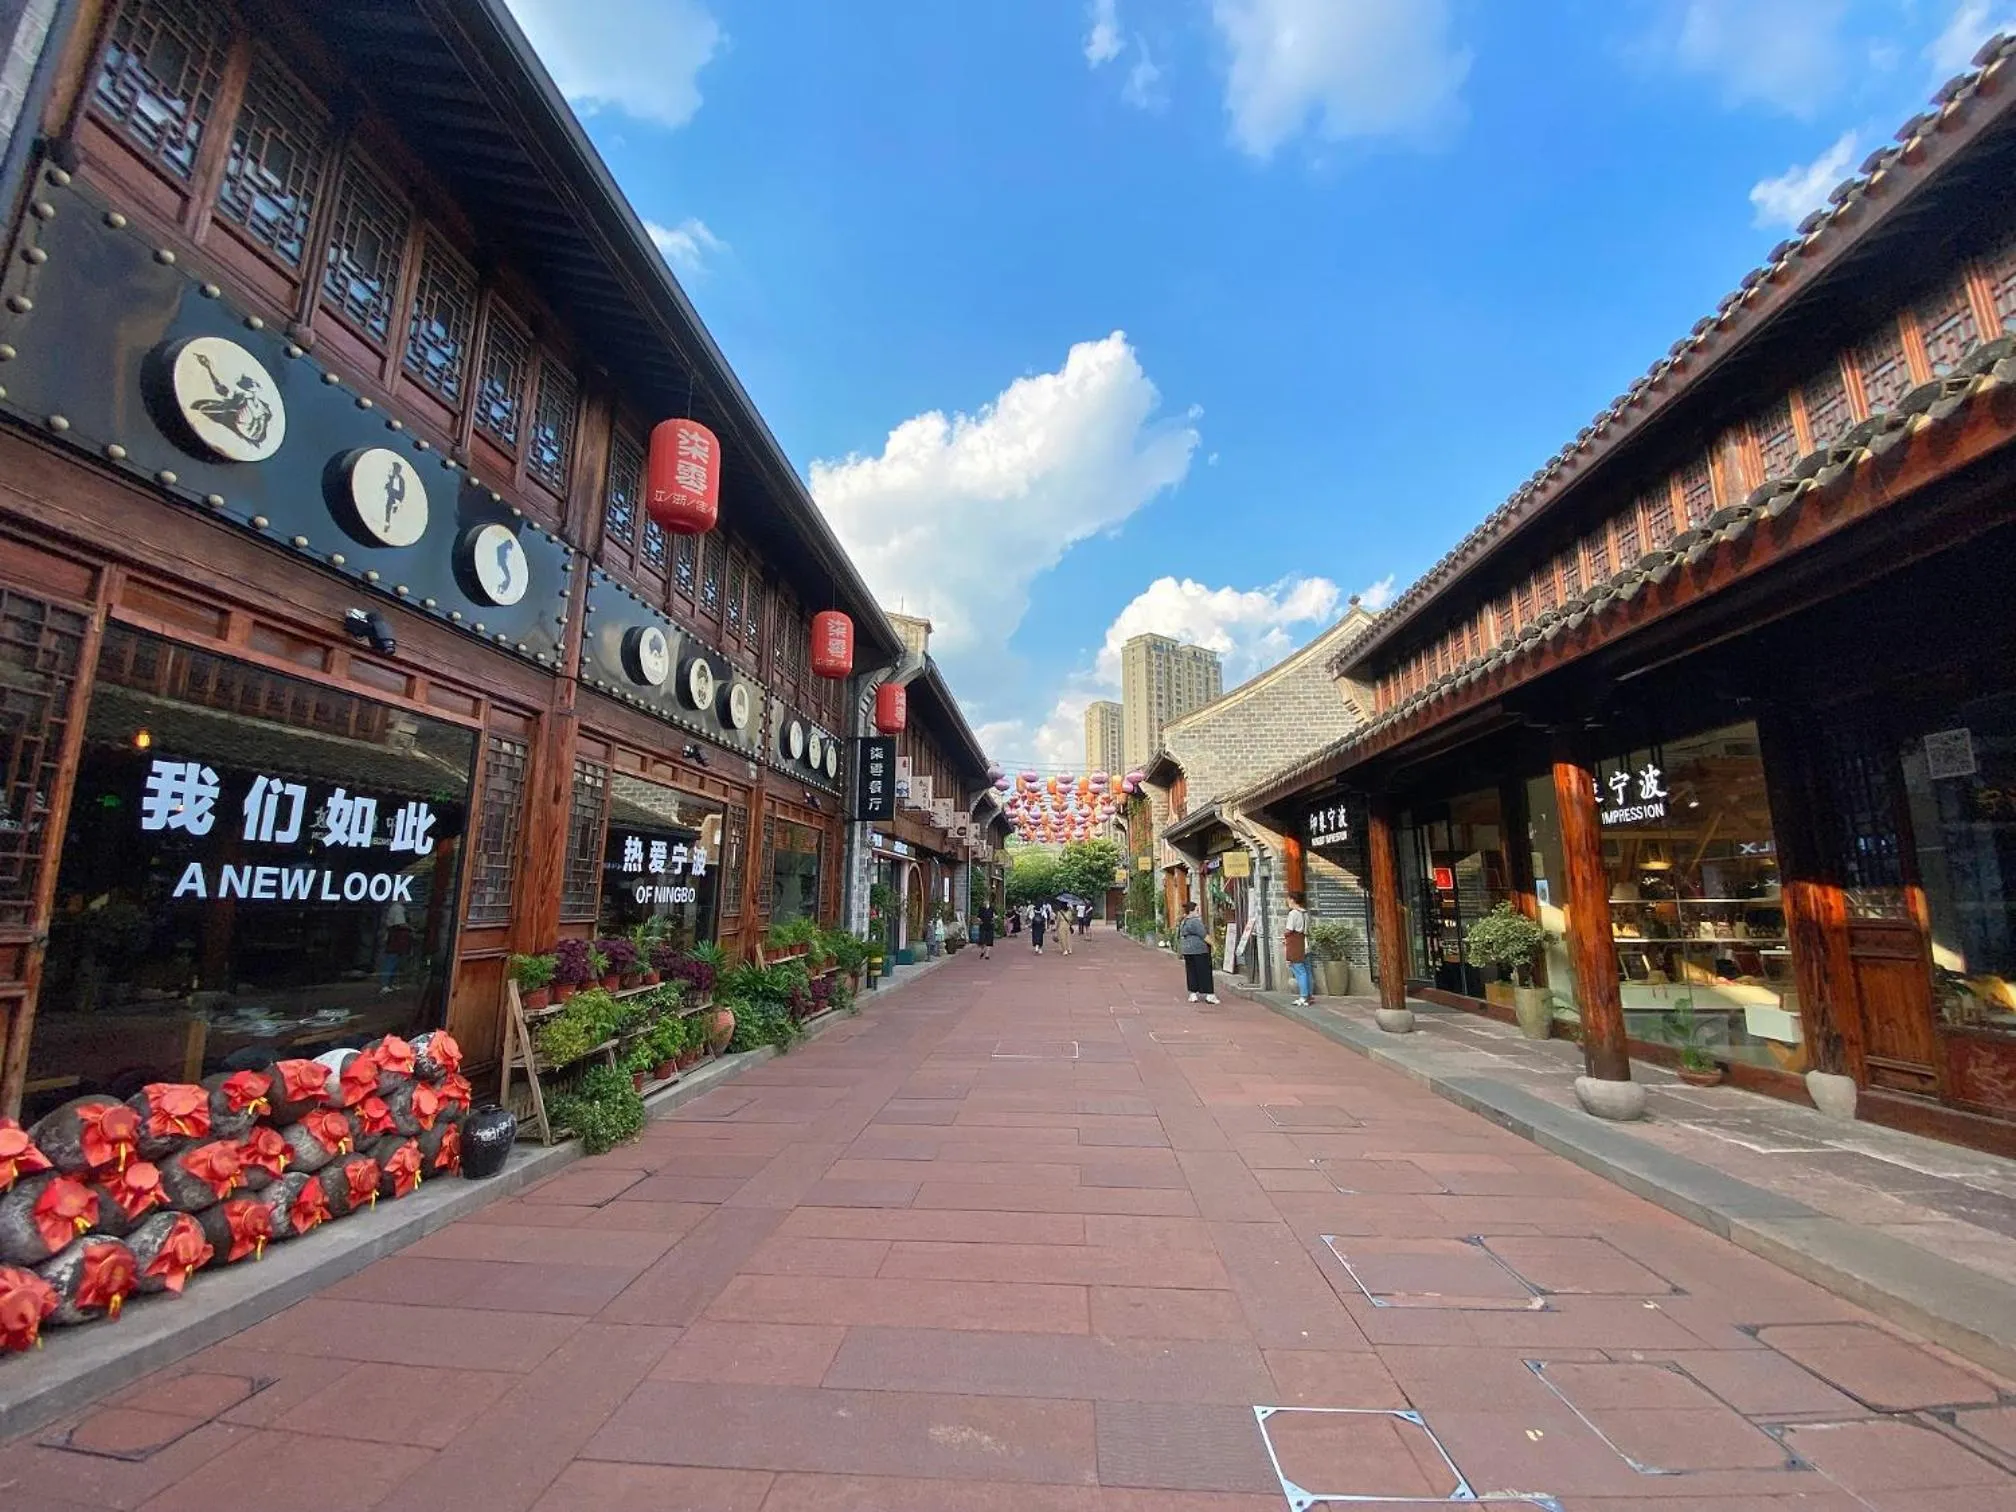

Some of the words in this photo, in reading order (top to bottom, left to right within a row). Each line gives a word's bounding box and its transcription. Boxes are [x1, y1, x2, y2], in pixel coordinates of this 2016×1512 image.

[141, 760, 437, 856] 我们如此
[1601, 802, 1665, 825] IMPRESSION
[622, 835, 708, 878] 热爱宁波
[173, 862, 207, 898] A
[218, 865, 316, 900] NEW
[321, 870, 414, 902] LOOK
[635, 885, 653, 904] OF
[654, 885, 696, 904] NINGBO
